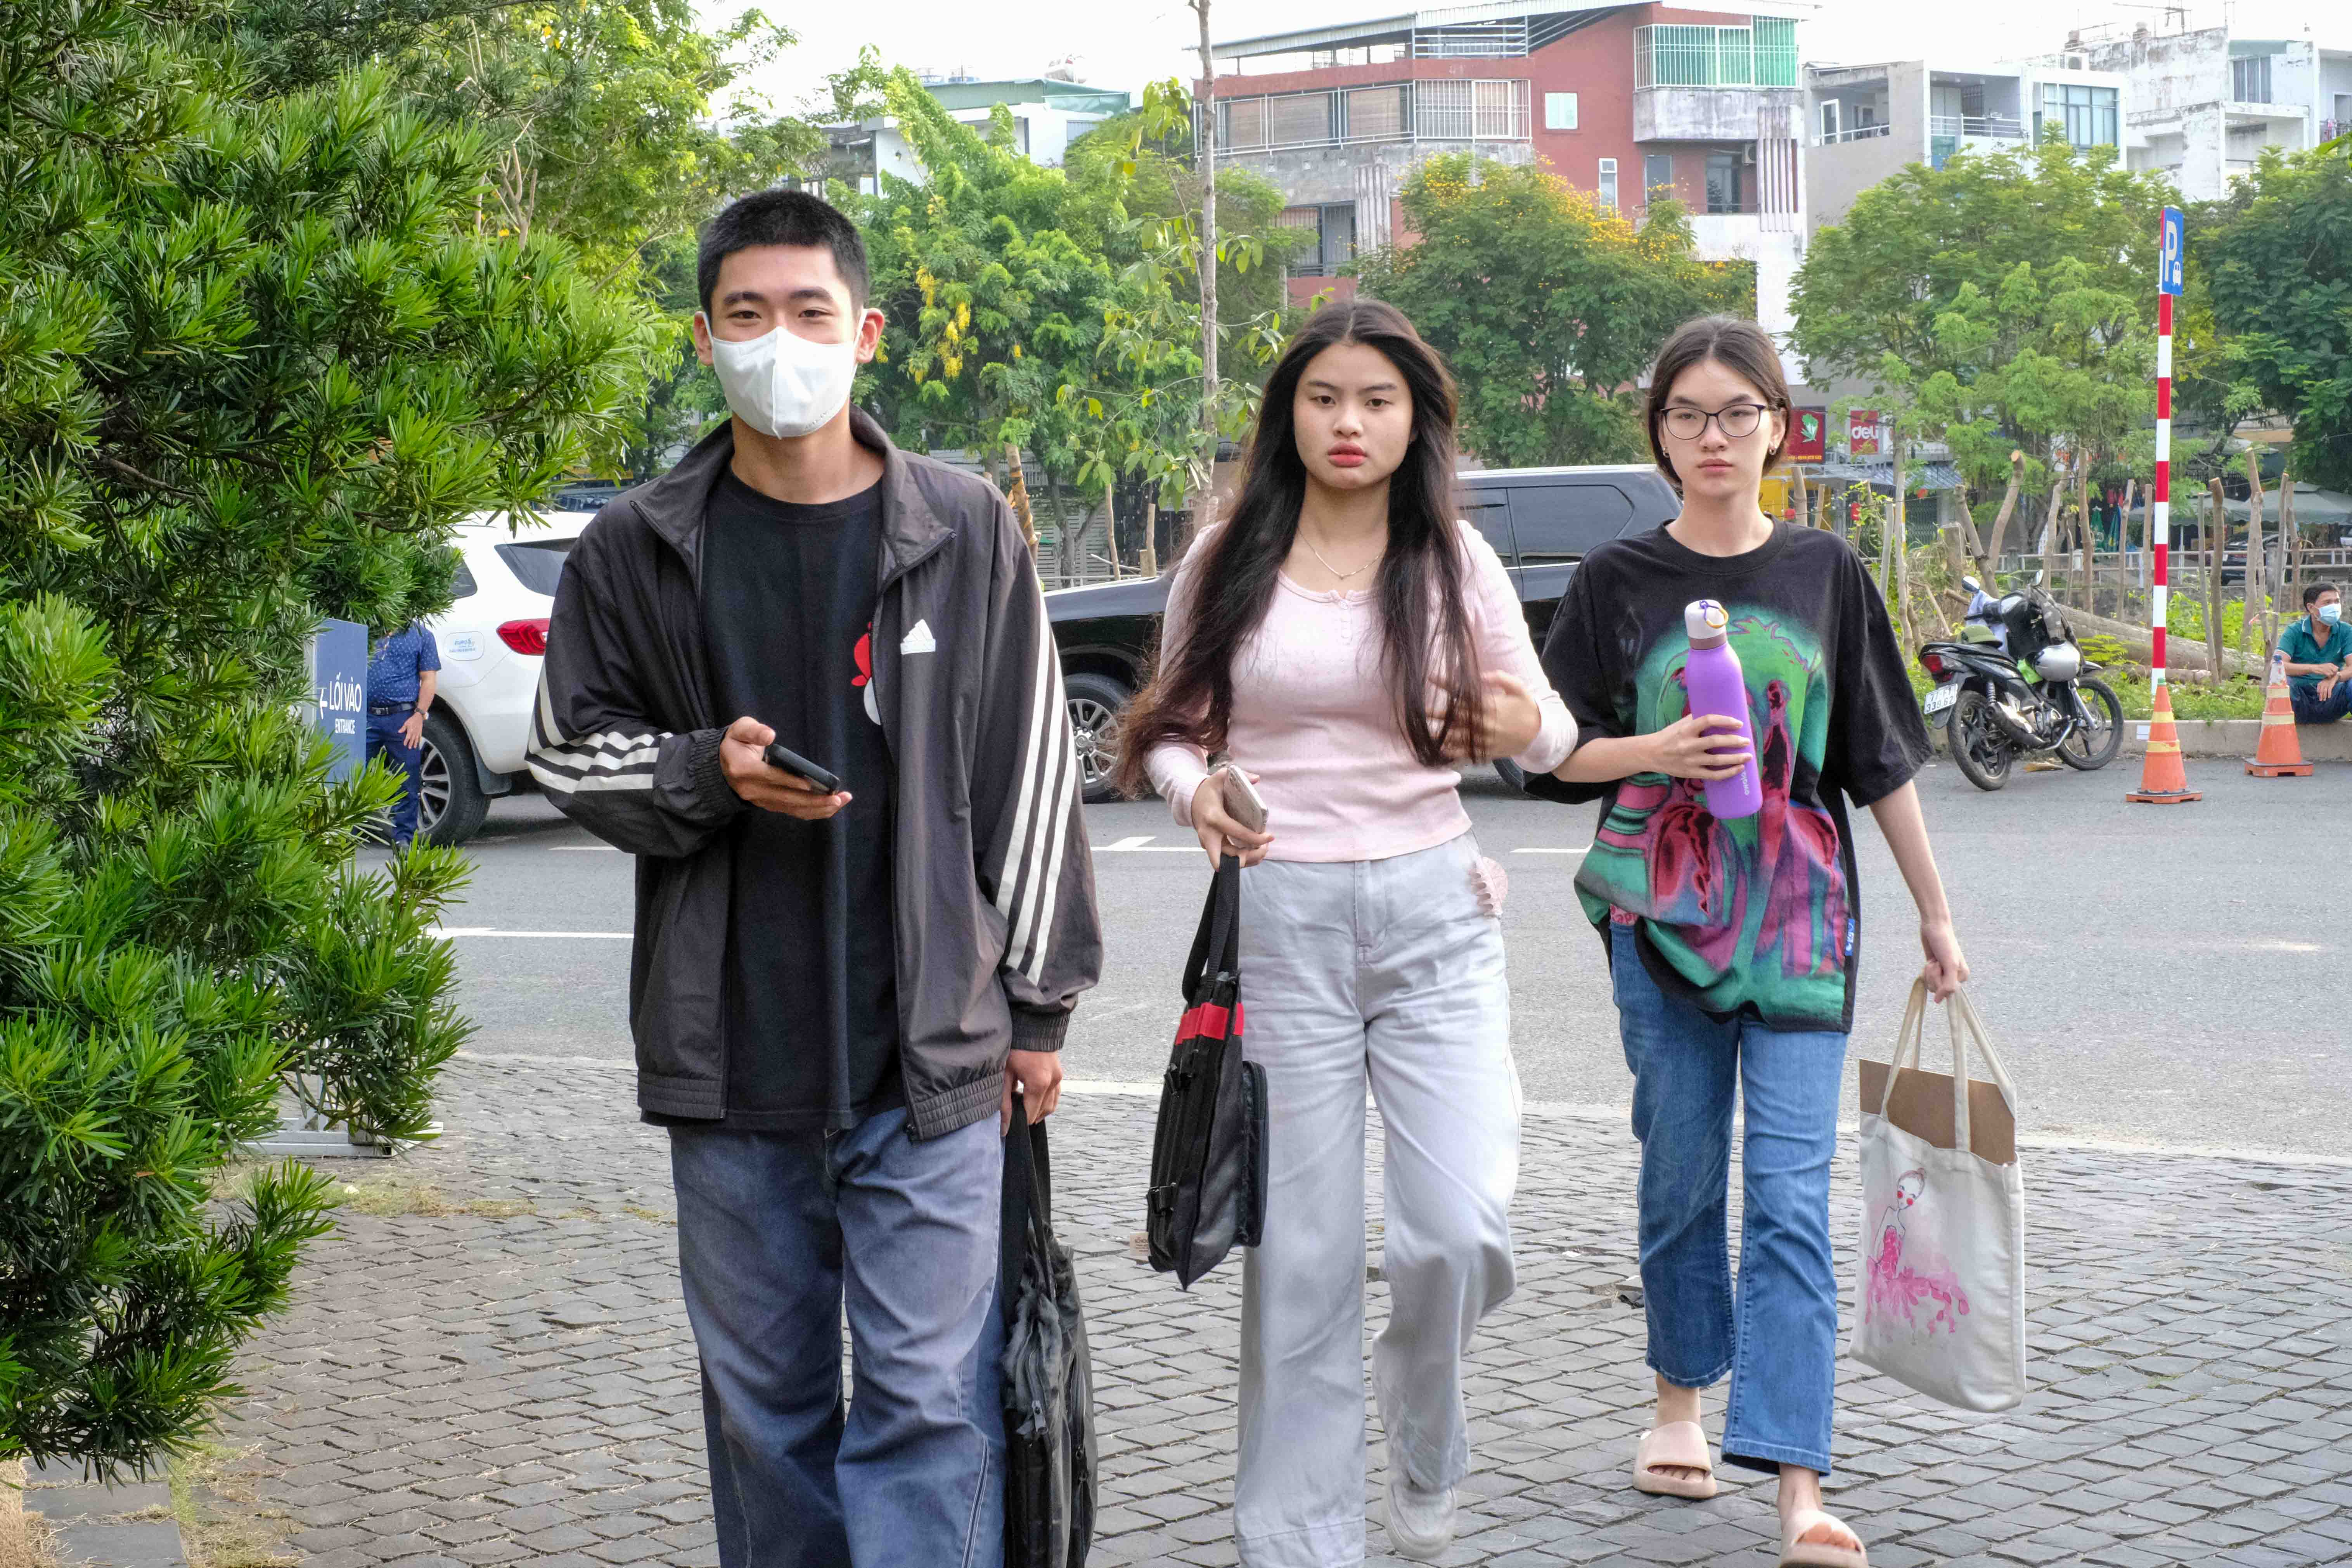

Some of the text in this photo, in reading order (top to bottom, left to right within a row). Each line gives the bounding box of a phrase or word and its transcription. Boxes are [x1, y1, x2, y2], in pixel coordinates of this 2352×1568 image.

[2165, 220, 2177, 282] P
[330, 672, 362, 712] LỐI VÀO
[335, 718, 355, 734] ENTRANCE
